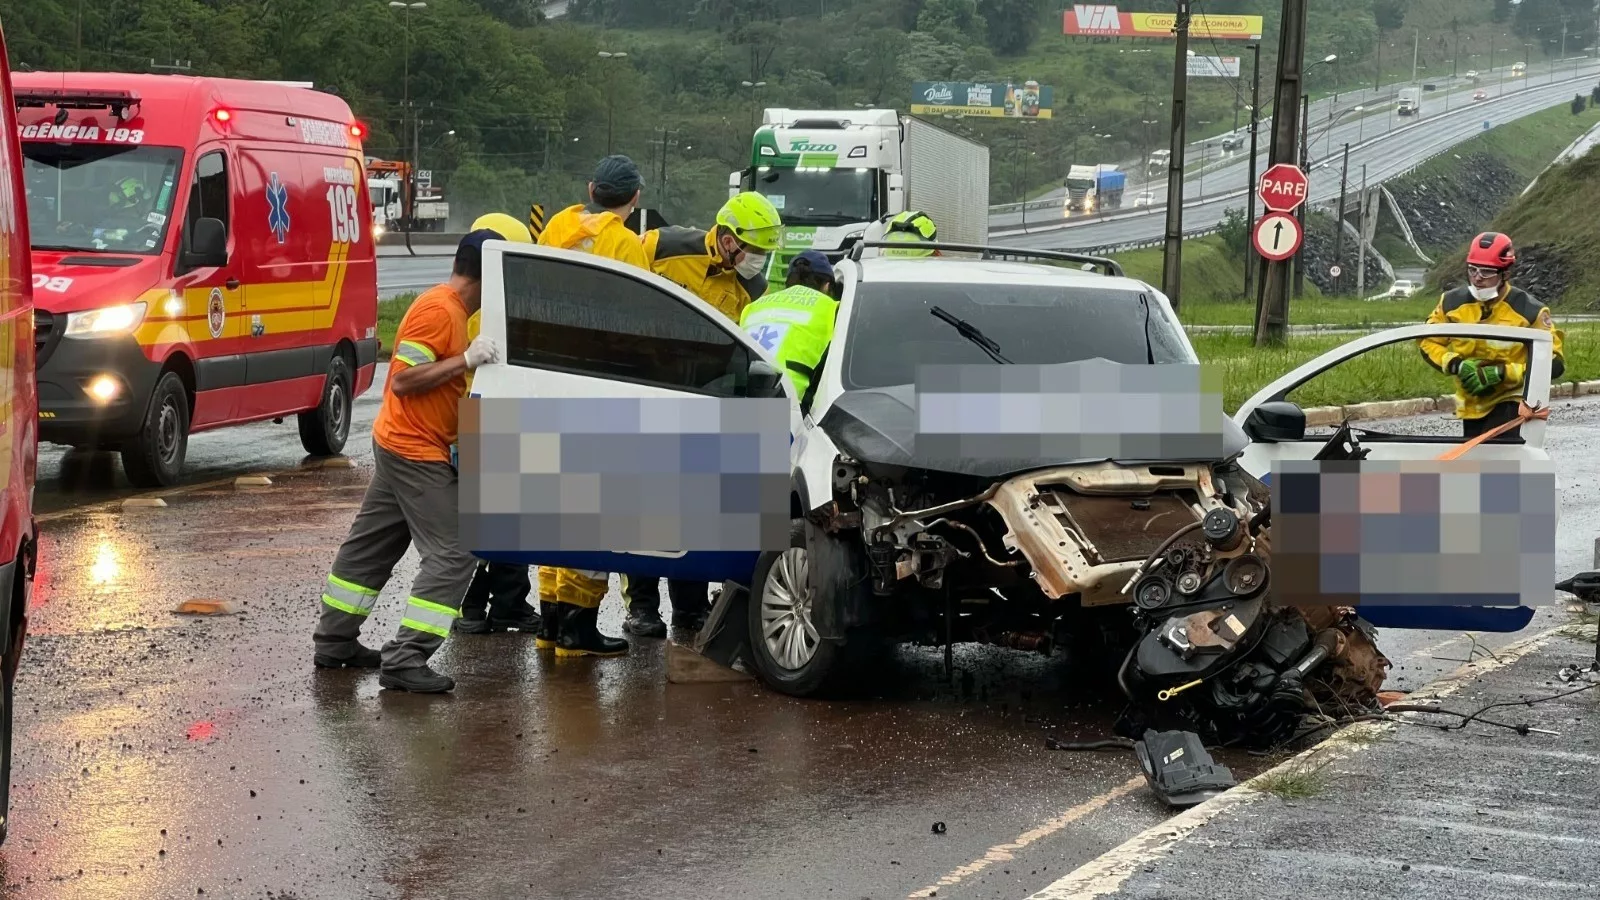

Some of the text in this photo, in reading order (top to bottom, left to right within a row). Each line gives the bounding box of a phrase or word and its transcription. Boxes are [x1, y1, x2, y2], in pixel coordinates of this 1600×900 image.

[1201, 20, 1243, 28] ECONOMIA
[924, 87, 952, 101] Dalla
[105, 127, 144, 143] 193
[1262, 179, 1304, 196] PARE
[326, 185, 359, 243] 193
